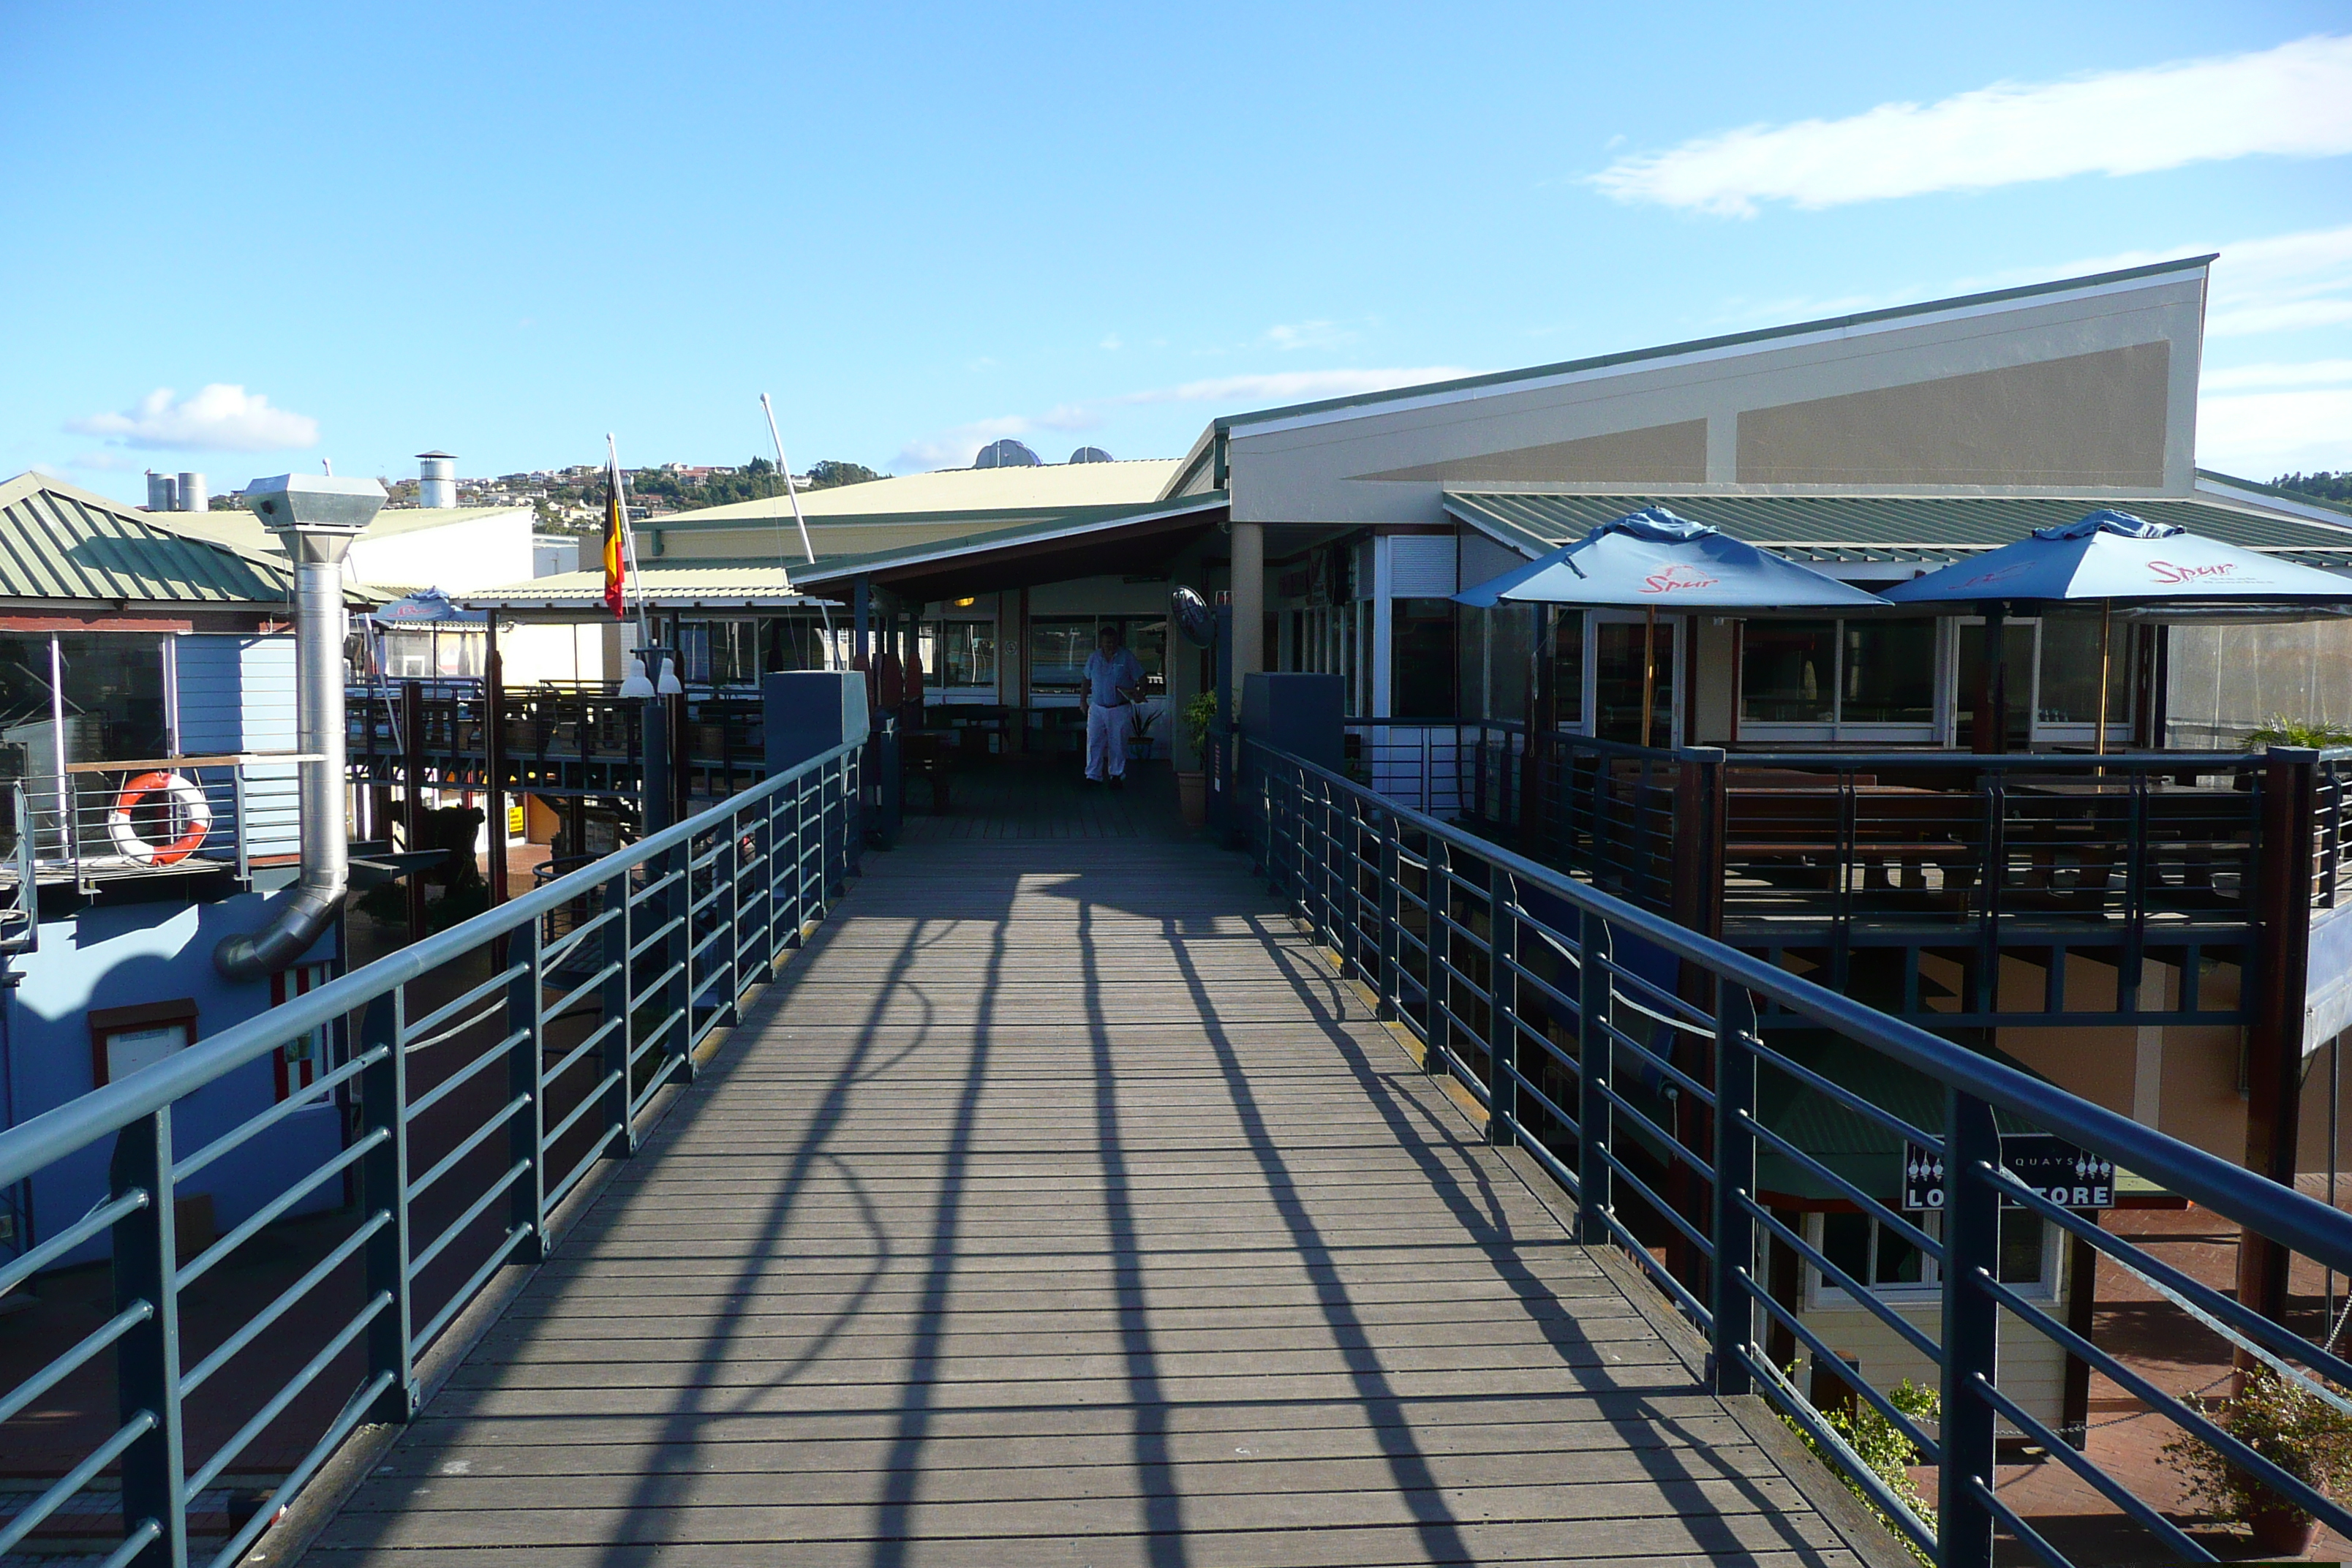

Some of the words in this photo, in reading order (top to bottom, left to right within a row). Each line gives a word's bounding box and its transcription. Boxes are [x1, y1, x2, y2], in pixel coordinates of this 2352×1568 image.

[2147, 560, 2236, 584] Spur
[1637, 575, 1719, 594] Spur
[2015, 1157, 2074, 1166] QUAYS
